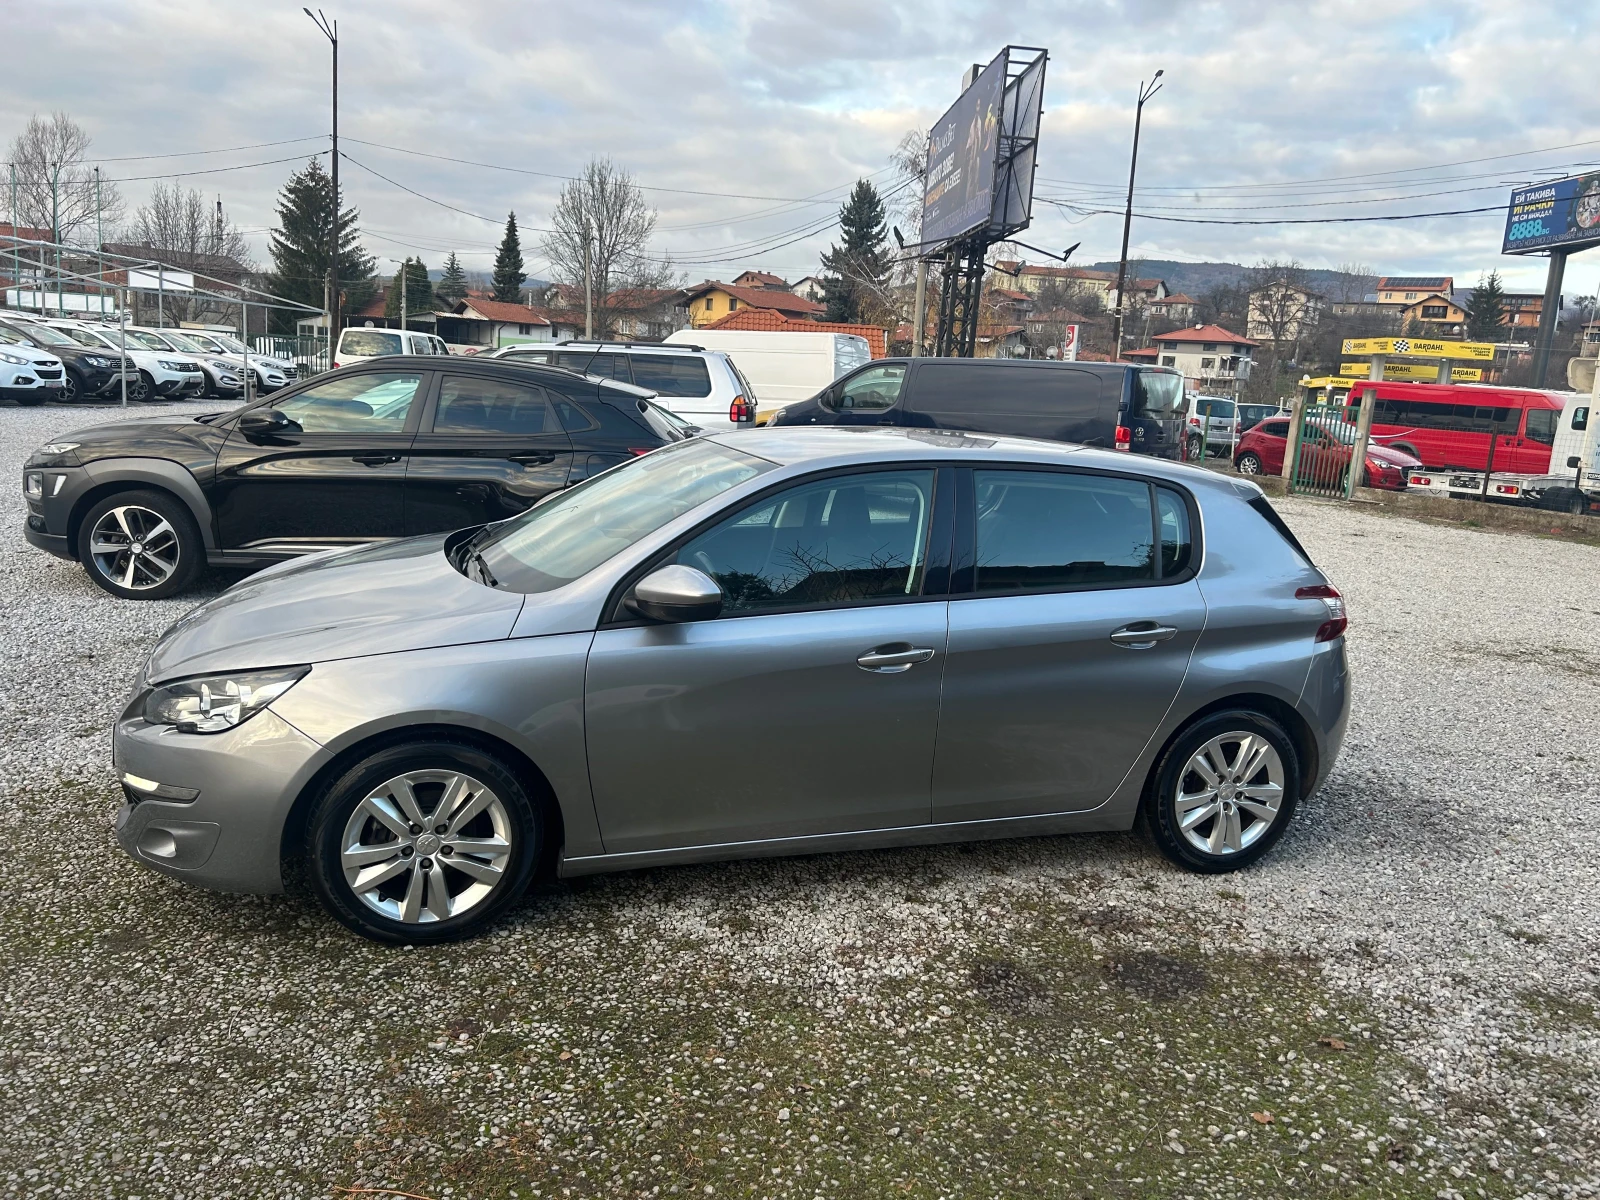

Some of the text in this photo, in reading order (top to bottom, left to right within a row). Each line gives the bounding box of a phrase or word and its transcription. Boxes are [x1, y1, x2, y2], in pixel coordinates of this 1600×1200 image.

[1515, 187, 1555, 204] ЕЙ ТАКИВА
[1413, 343, 1444, 352] BARDAHL
[1452, 369, 1477, 378] ARDAHL
